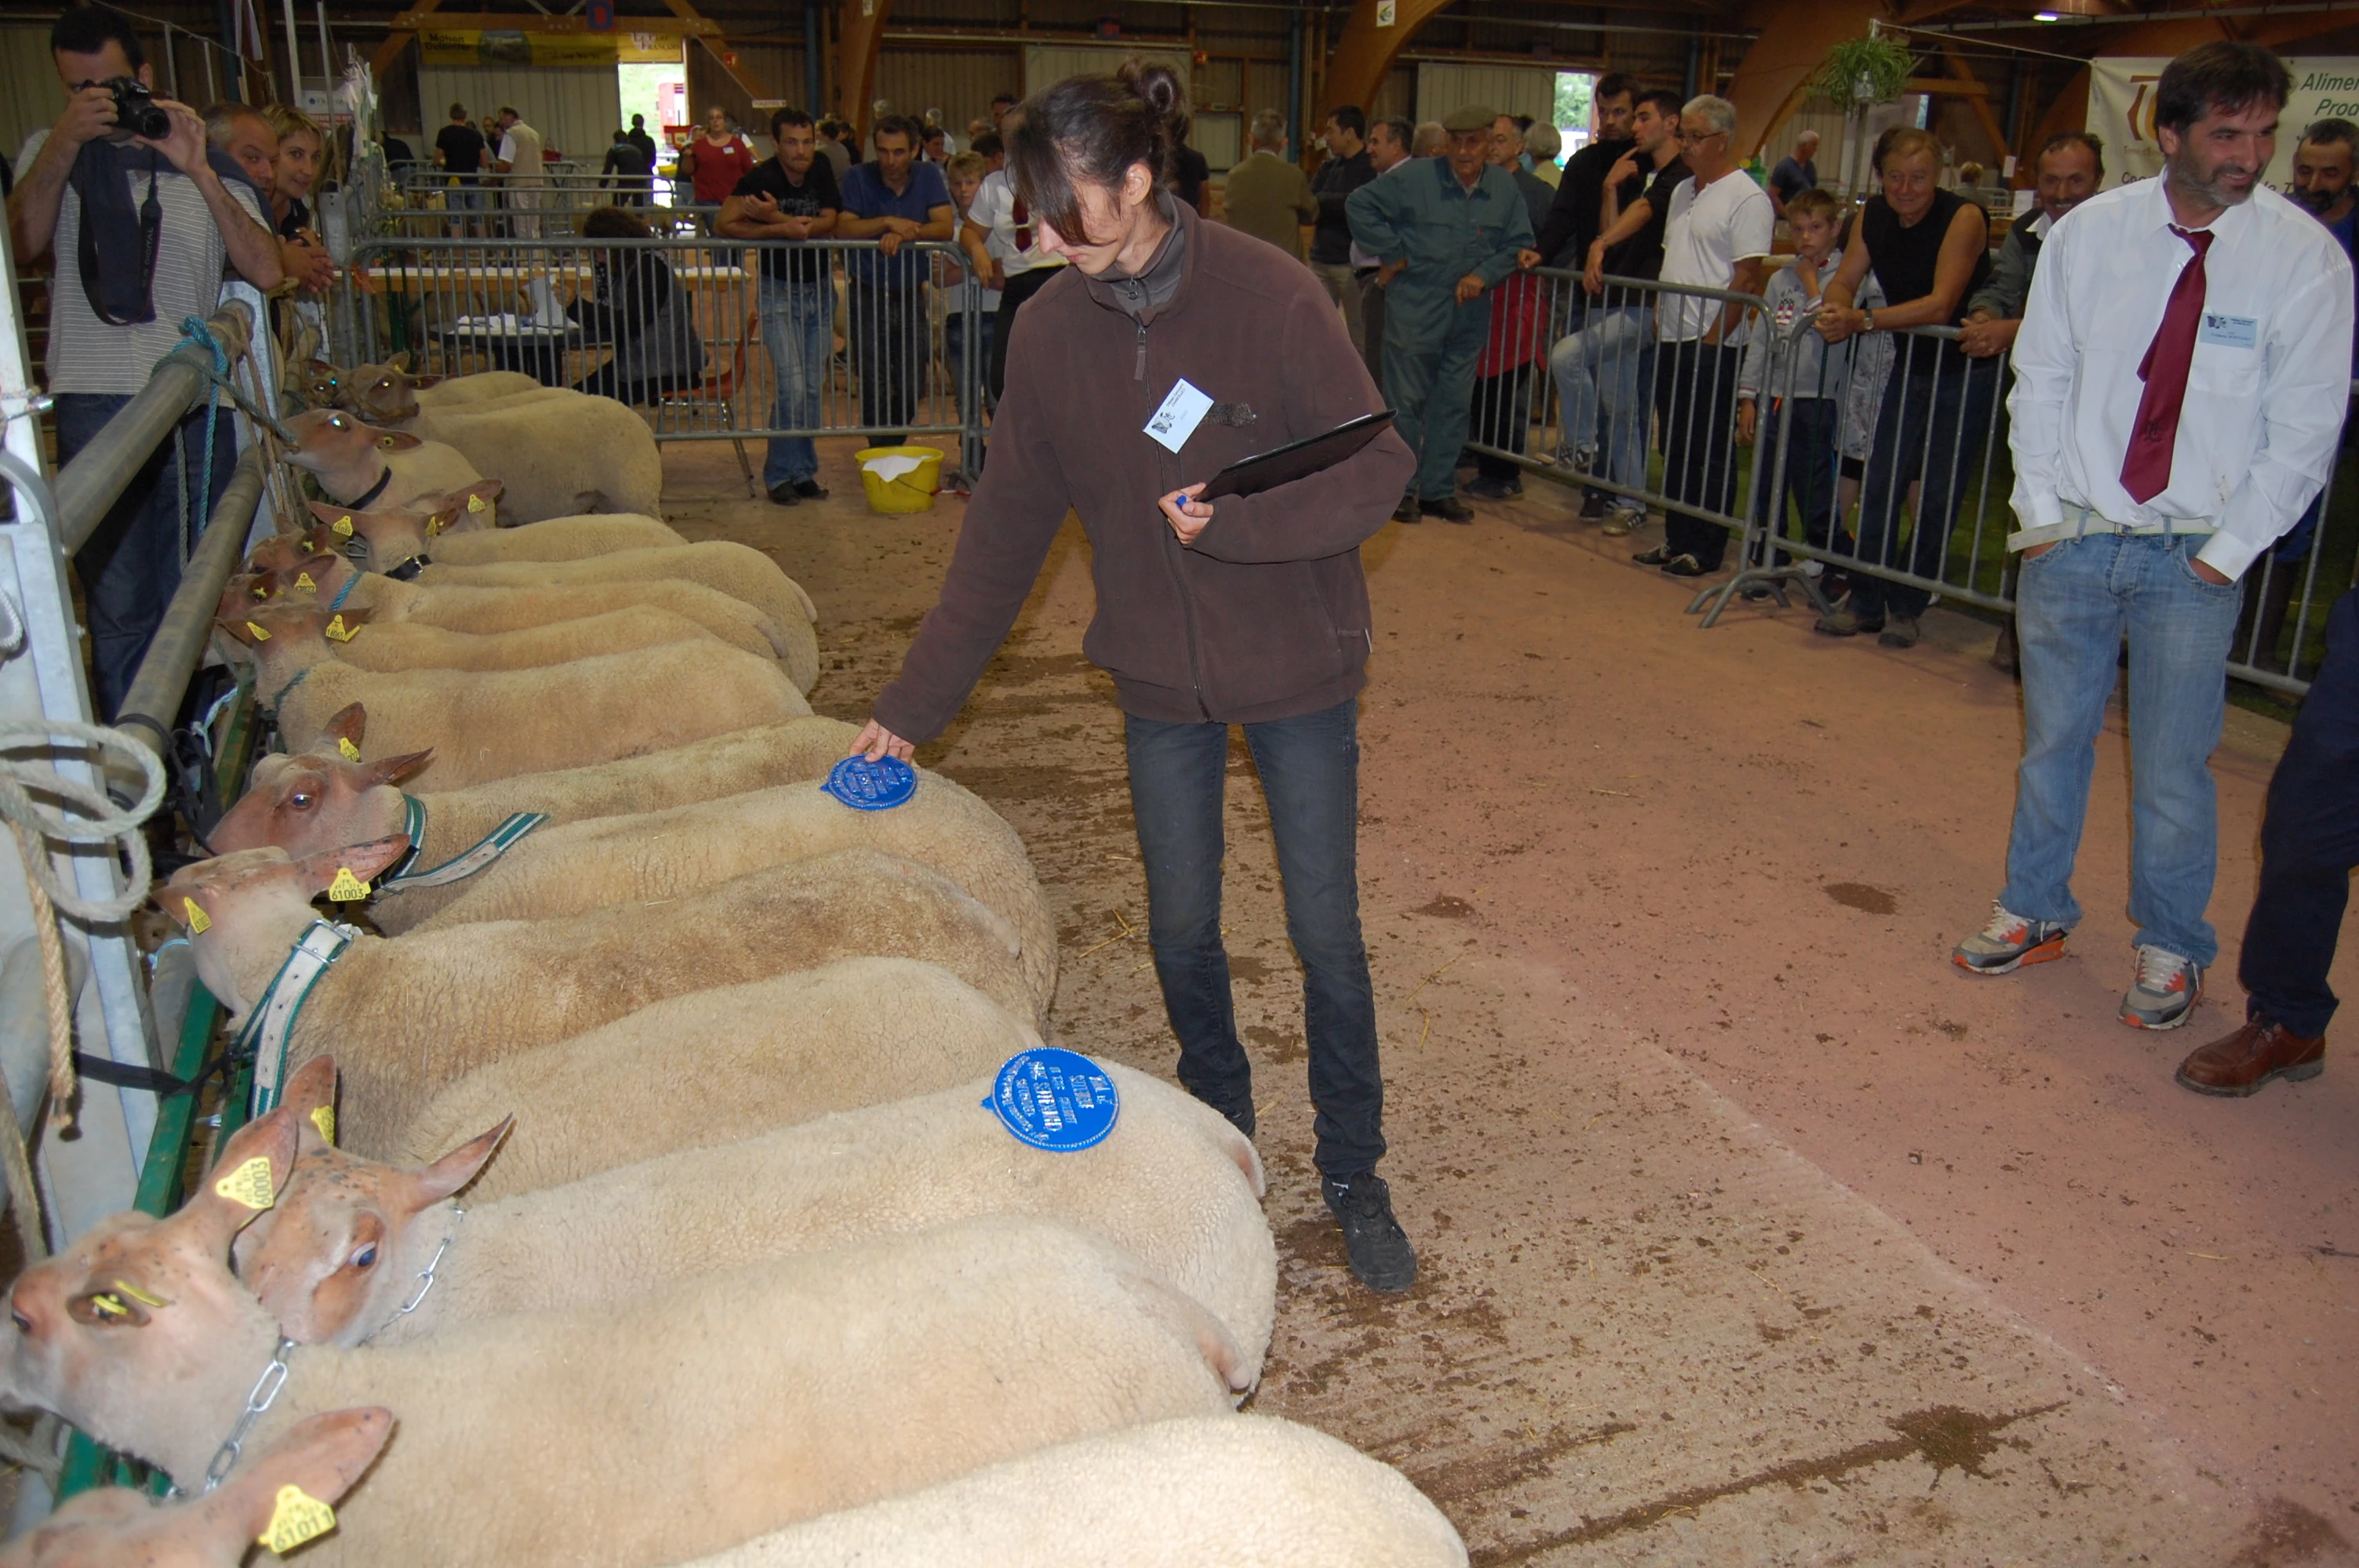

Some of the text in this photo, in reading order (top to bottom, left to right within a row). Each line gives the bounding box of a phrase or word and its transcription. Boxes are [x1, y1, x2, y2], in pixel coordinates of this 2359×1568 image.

[429, 34, 464, 42] Maison
[144, 226, 154, 266] DIGITAL
[332, 887, 365, 900] 61003
[1034, 1083, 1062, 1131] CHAROLLES
[251, 1161, 271, 1207] 60003
[274, 1509, 333, 1551] 61011
